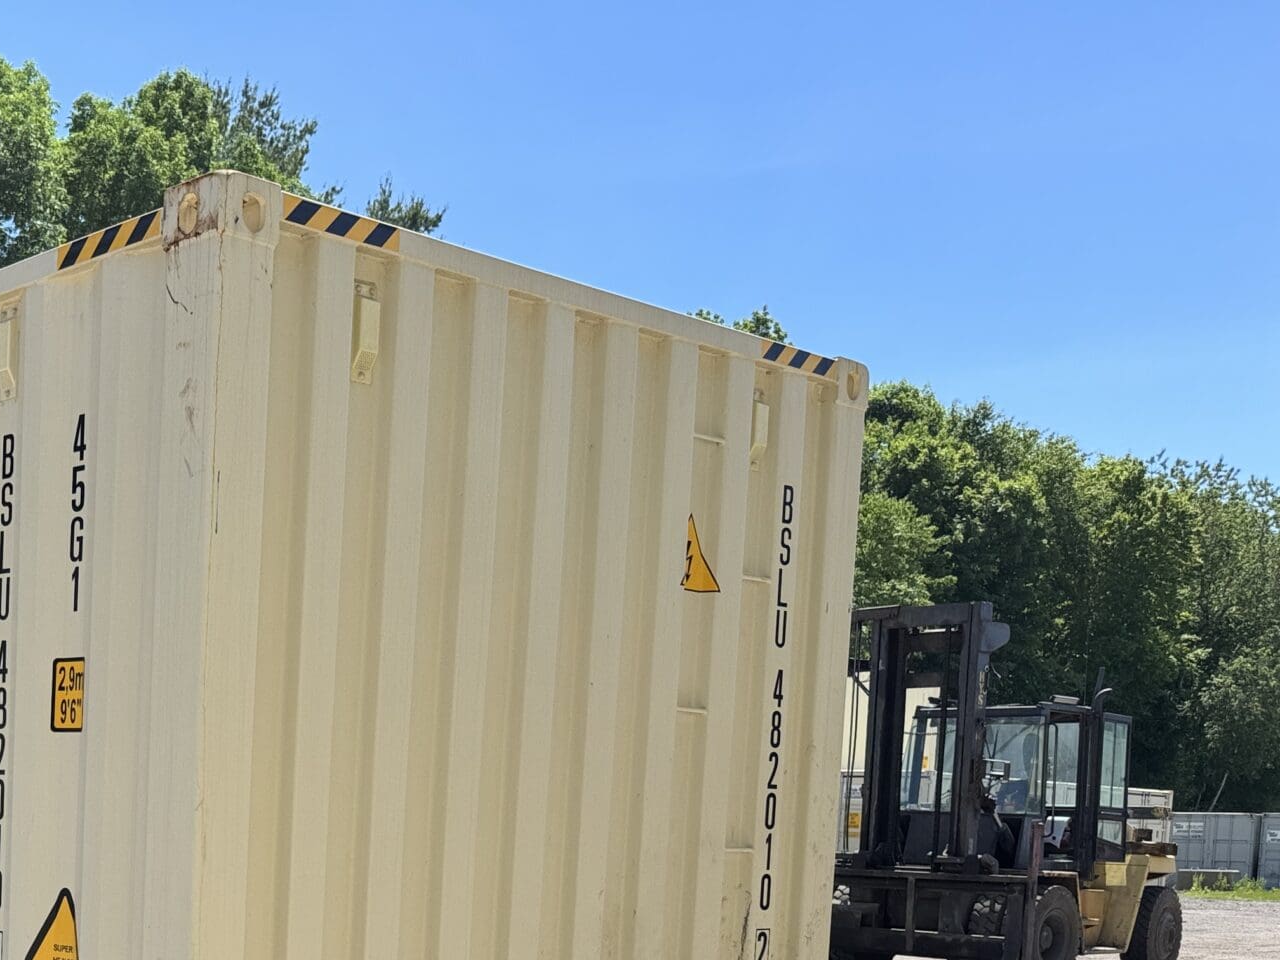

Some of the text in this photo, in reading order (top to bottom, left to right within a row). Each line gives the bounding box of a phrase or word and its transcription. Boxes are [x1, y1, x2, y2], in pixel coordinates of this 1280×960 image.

[70, 413, 87, 612] 45G1
[774, 484, 794, 648] BSLU
[759, 669, 784, 911] 482010
[53, 943, 73, 953] SUPER
